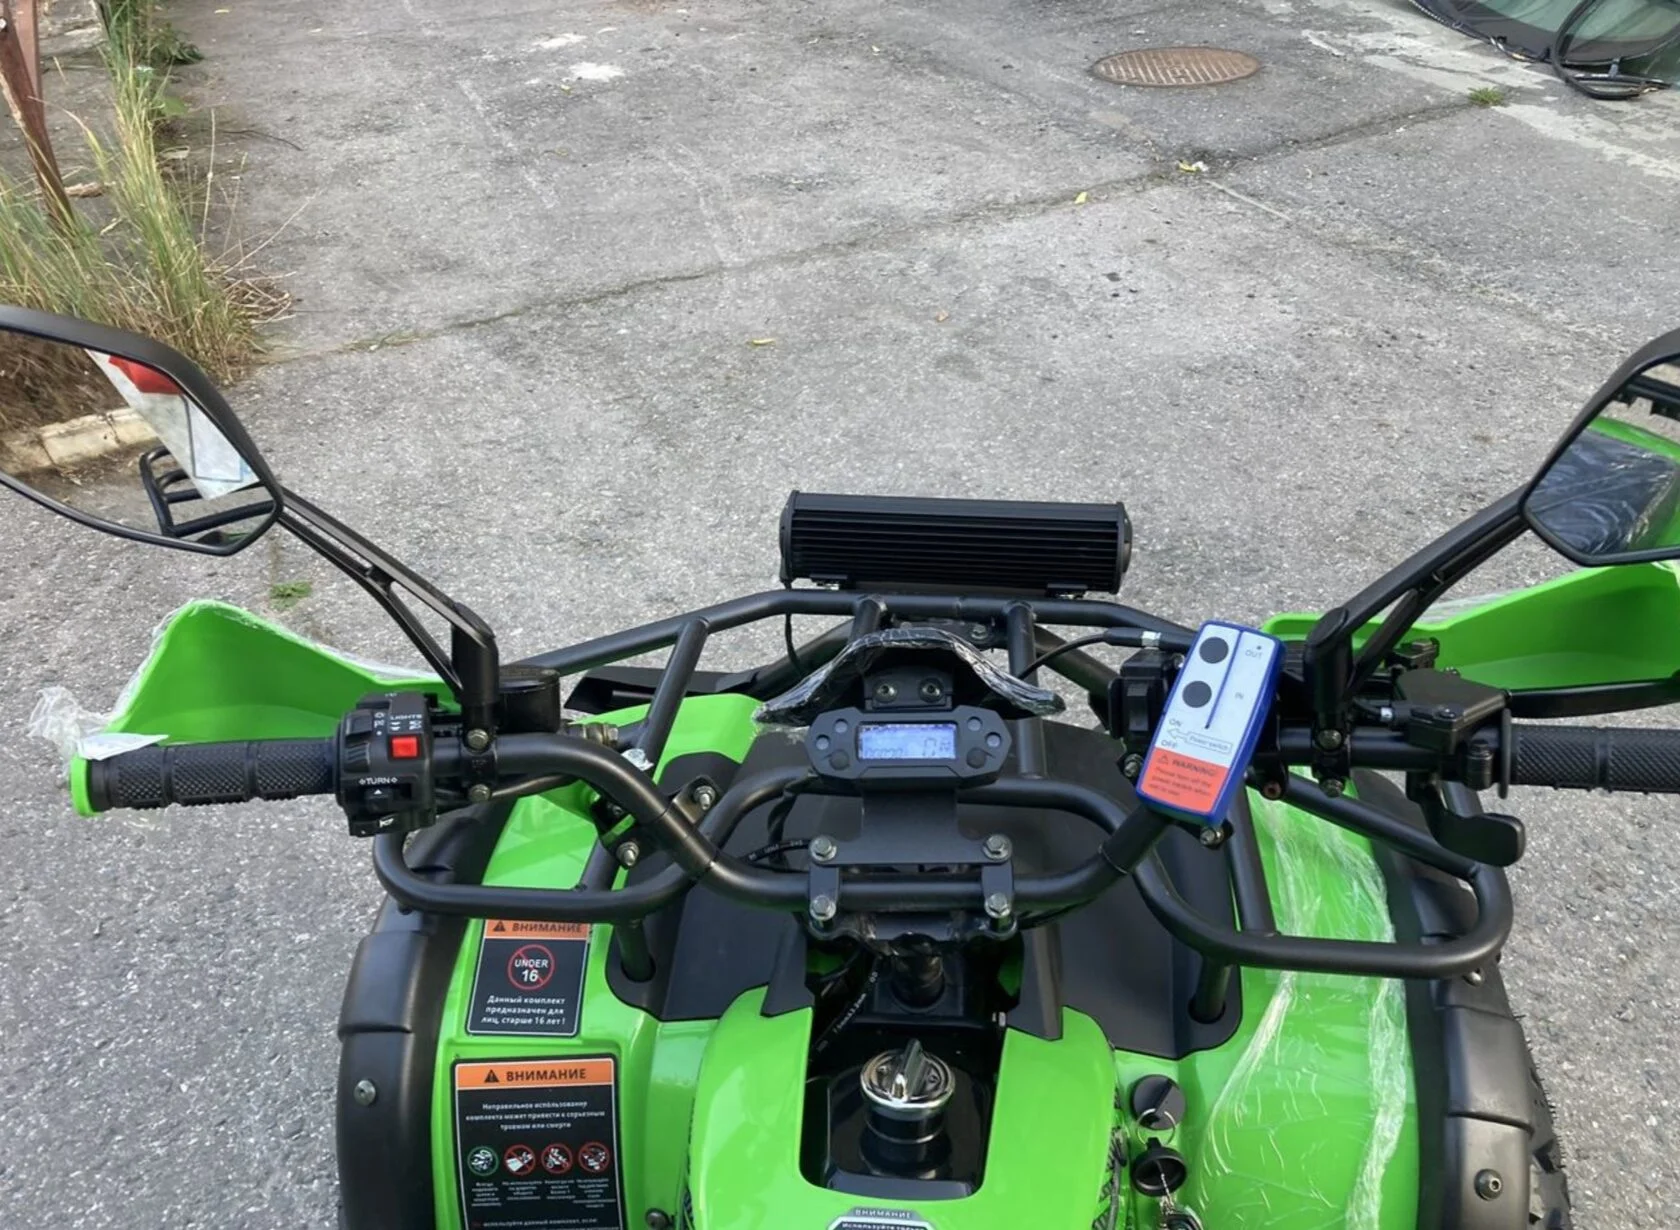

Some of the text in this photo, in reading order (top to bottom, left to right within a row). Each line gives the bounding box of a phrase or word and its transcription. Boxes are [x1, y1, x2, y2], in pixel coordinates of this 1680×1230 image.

[1245, 649, 1262, 660] OUT
[365, 777, 391, 785] TURN
[512, 922, 583, 933] ВНИМАНИЕ
[514, 958, 549, 969] UNDER
[521, 969, 539, 983] 16
[487, 995, 522, 1004] Данный
[485, 1006, 547, 1015] предназначен
[501, 1017, 533, 1026] старше
[534, 1016, 545, 1025] 16
[506, 1068, 587, 1082] ВНИМАНИЕ
[855, 1208, 911, 1219] ВНИМАНИЕ
